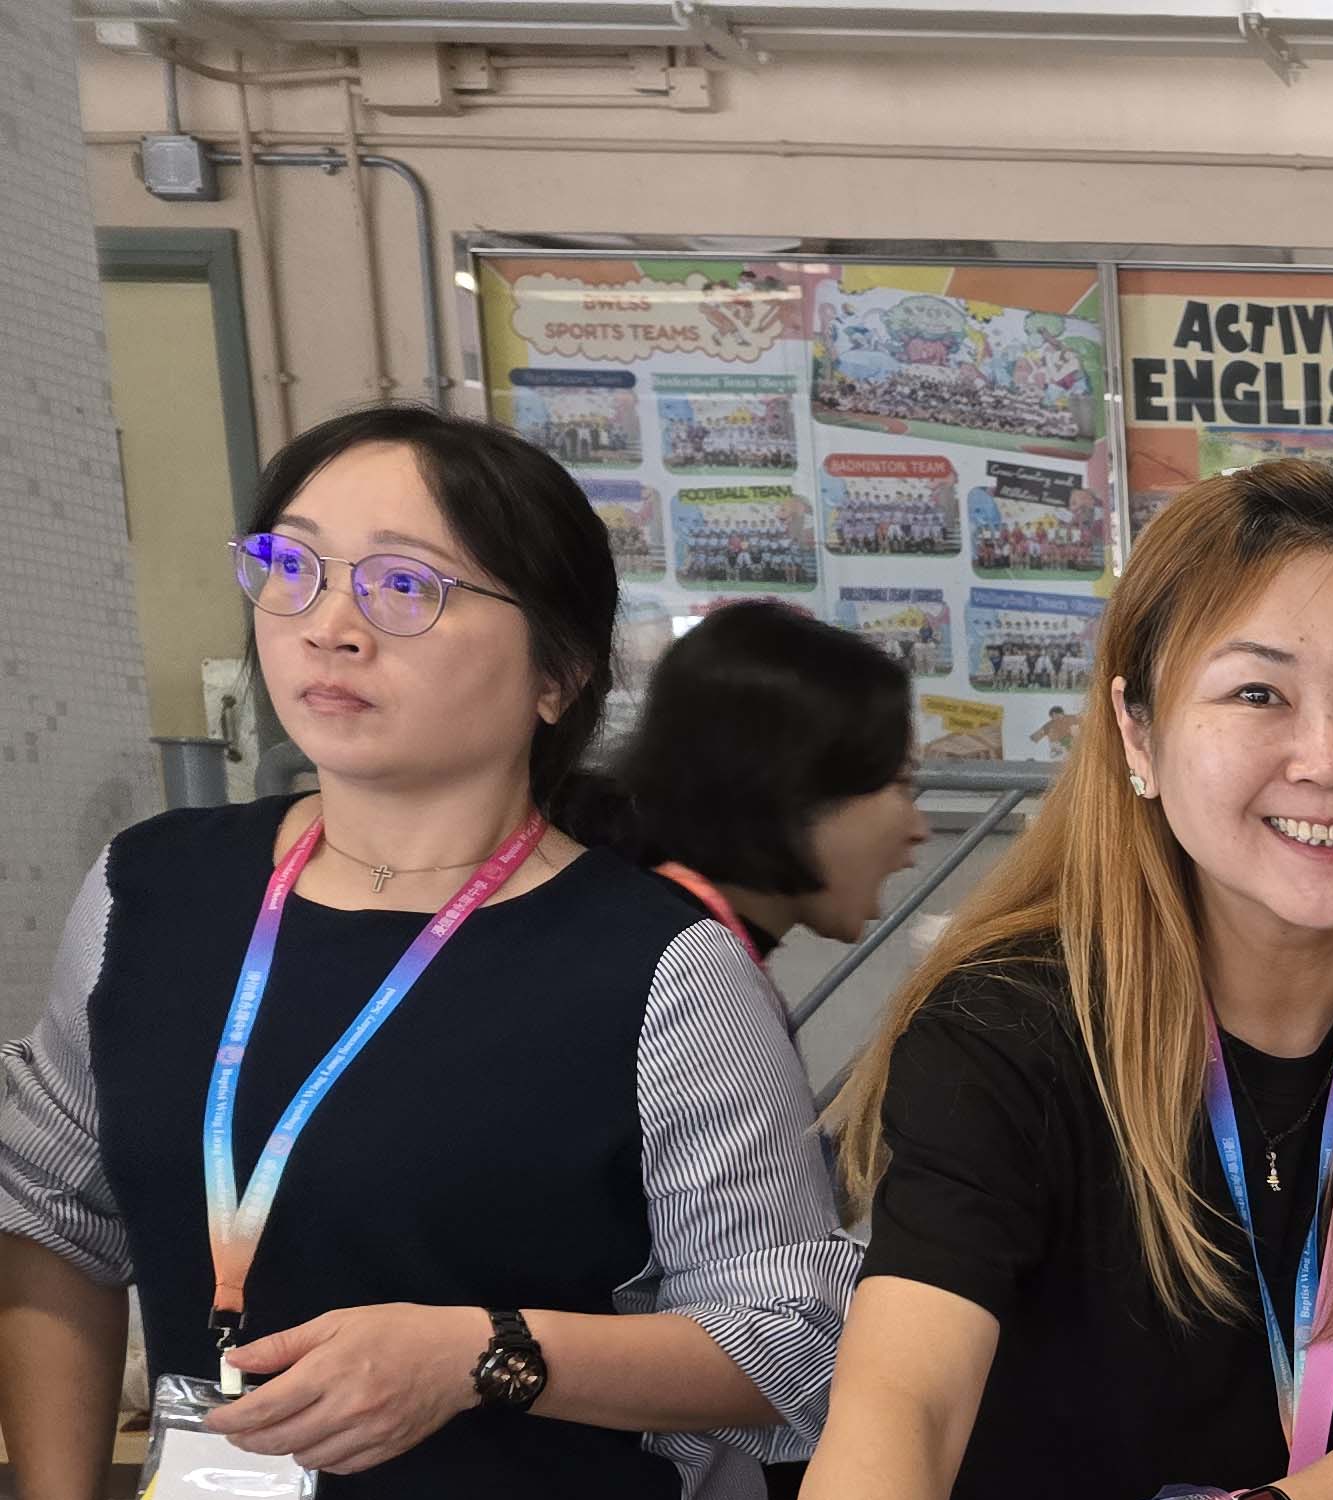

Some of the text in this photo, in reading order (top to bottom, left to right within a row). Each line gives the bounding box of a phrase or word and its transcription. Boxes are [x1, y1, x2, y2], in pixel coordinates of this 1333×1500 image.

[544, 322, 700, 342] SPORTS TEAMS
[830, 459, 946, 475] BADMINTON TEAM
[678, 484, 793, 502] FOOTBALL TEAM
[1300, 1284, 1313, 1319] Baptist
